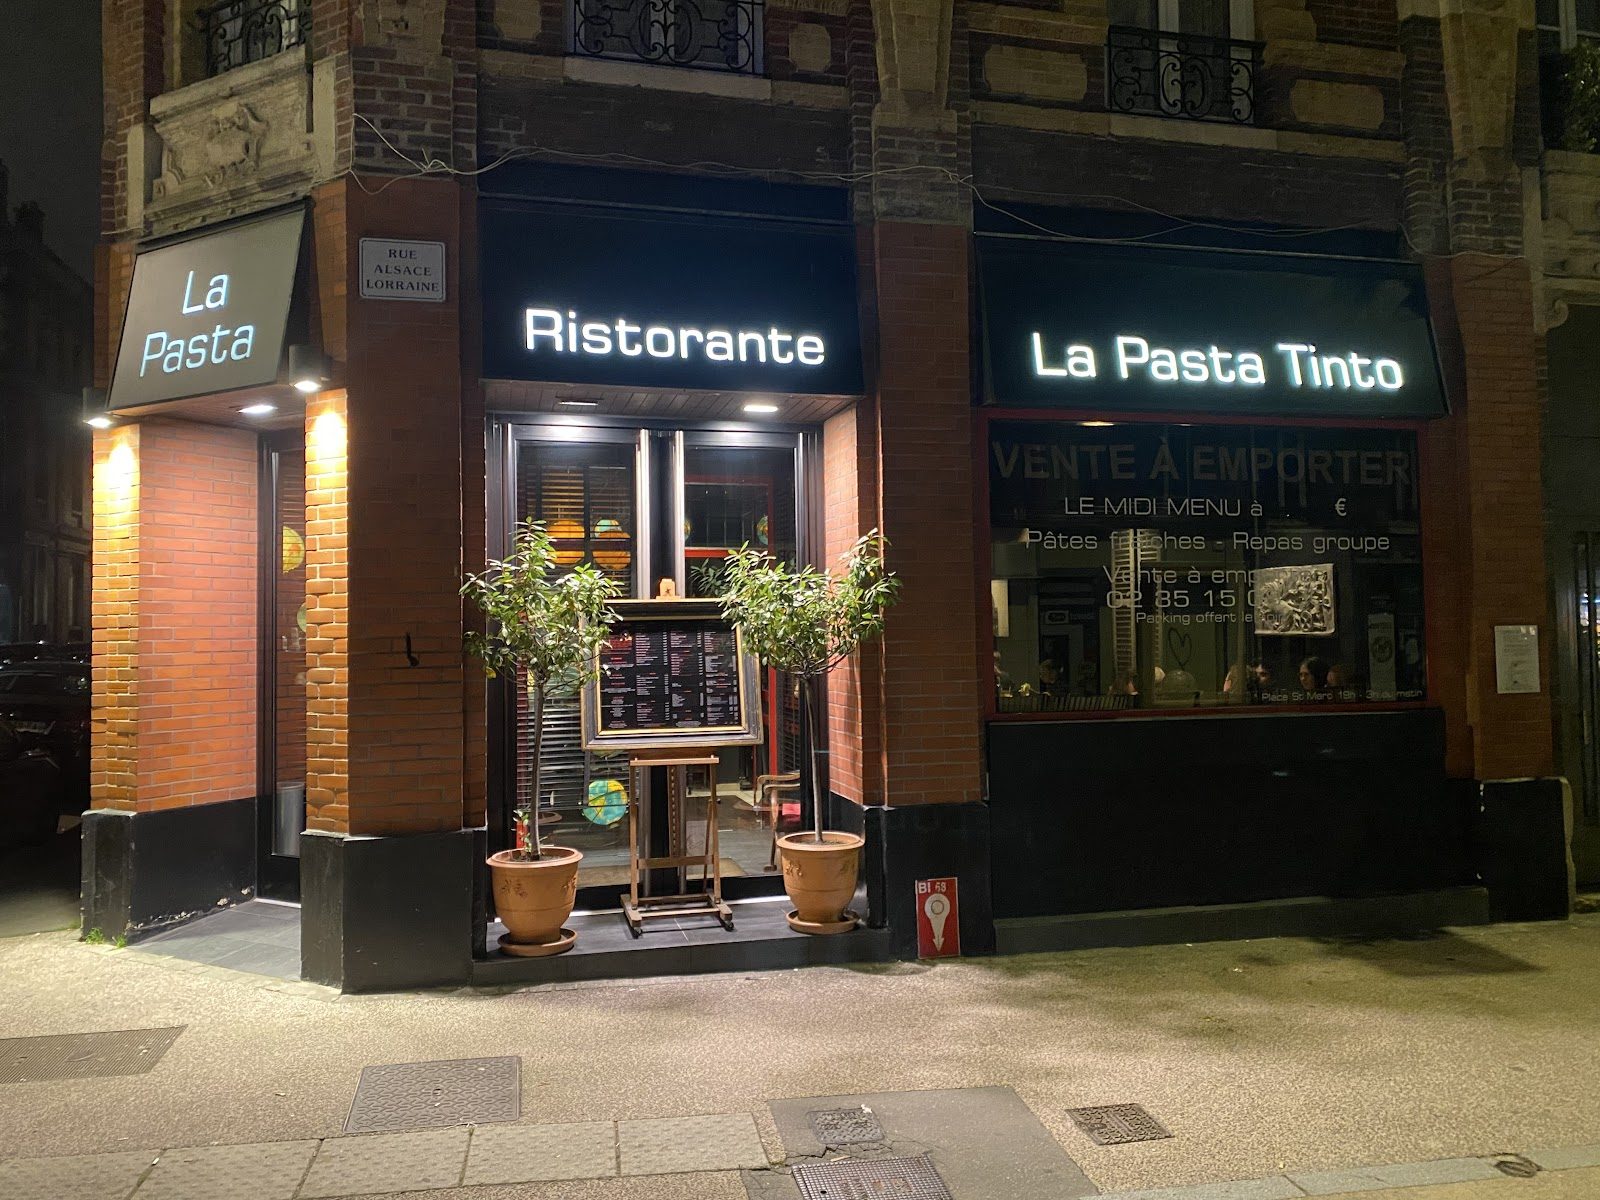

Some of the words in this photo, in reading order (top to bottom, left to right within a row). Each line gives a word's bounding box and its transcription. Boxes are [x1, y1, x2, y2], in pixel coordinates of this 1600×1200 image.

[387, 248, 417, 260] RUE
[373, 264, 433, 277] ALSACE
[181, 270, 229, 315] La
[365, 279, 440, 293] LORRAINE
[525, 307, 826, 366] Ristorante
[139, 324, 255, 378] Pasta
[1031, 331, 1097, 379] La
[1115, 335, 1266, 384] Pasta
[1277, 342, 1404, 390] Tinto
[992, 442, 1136, 480] VENTE
[1150, 436, 1180, 480] À
[1193, 446, 1411, 486] EMPORTER
[1064, 496, 1095, 516] LE
[1104, 497, 1157, 516] MIDI
[1167, 498, 1241, 517] MENU
[1250, 500, 1263, 517] à
[1334, 497, 1348, 517] €
[1026, 530, 1098, 550] Pâtes
[1233, 532, 1303, 553] Repas
[1313, 536, 1390, 554] groupe
[1102, 565, 1177, 584] Vente
[1187, 566, 1201, 584] à
[1106, 590, 1143, 609] 02
[1203, 590, 1236, 608] 15
[1136, 612, 1191, 626] Parking
[1195, 611, 1237, 624] offert
[1242, 611, 1254, 623] le
[1261, 692, 1289, 701] Place
